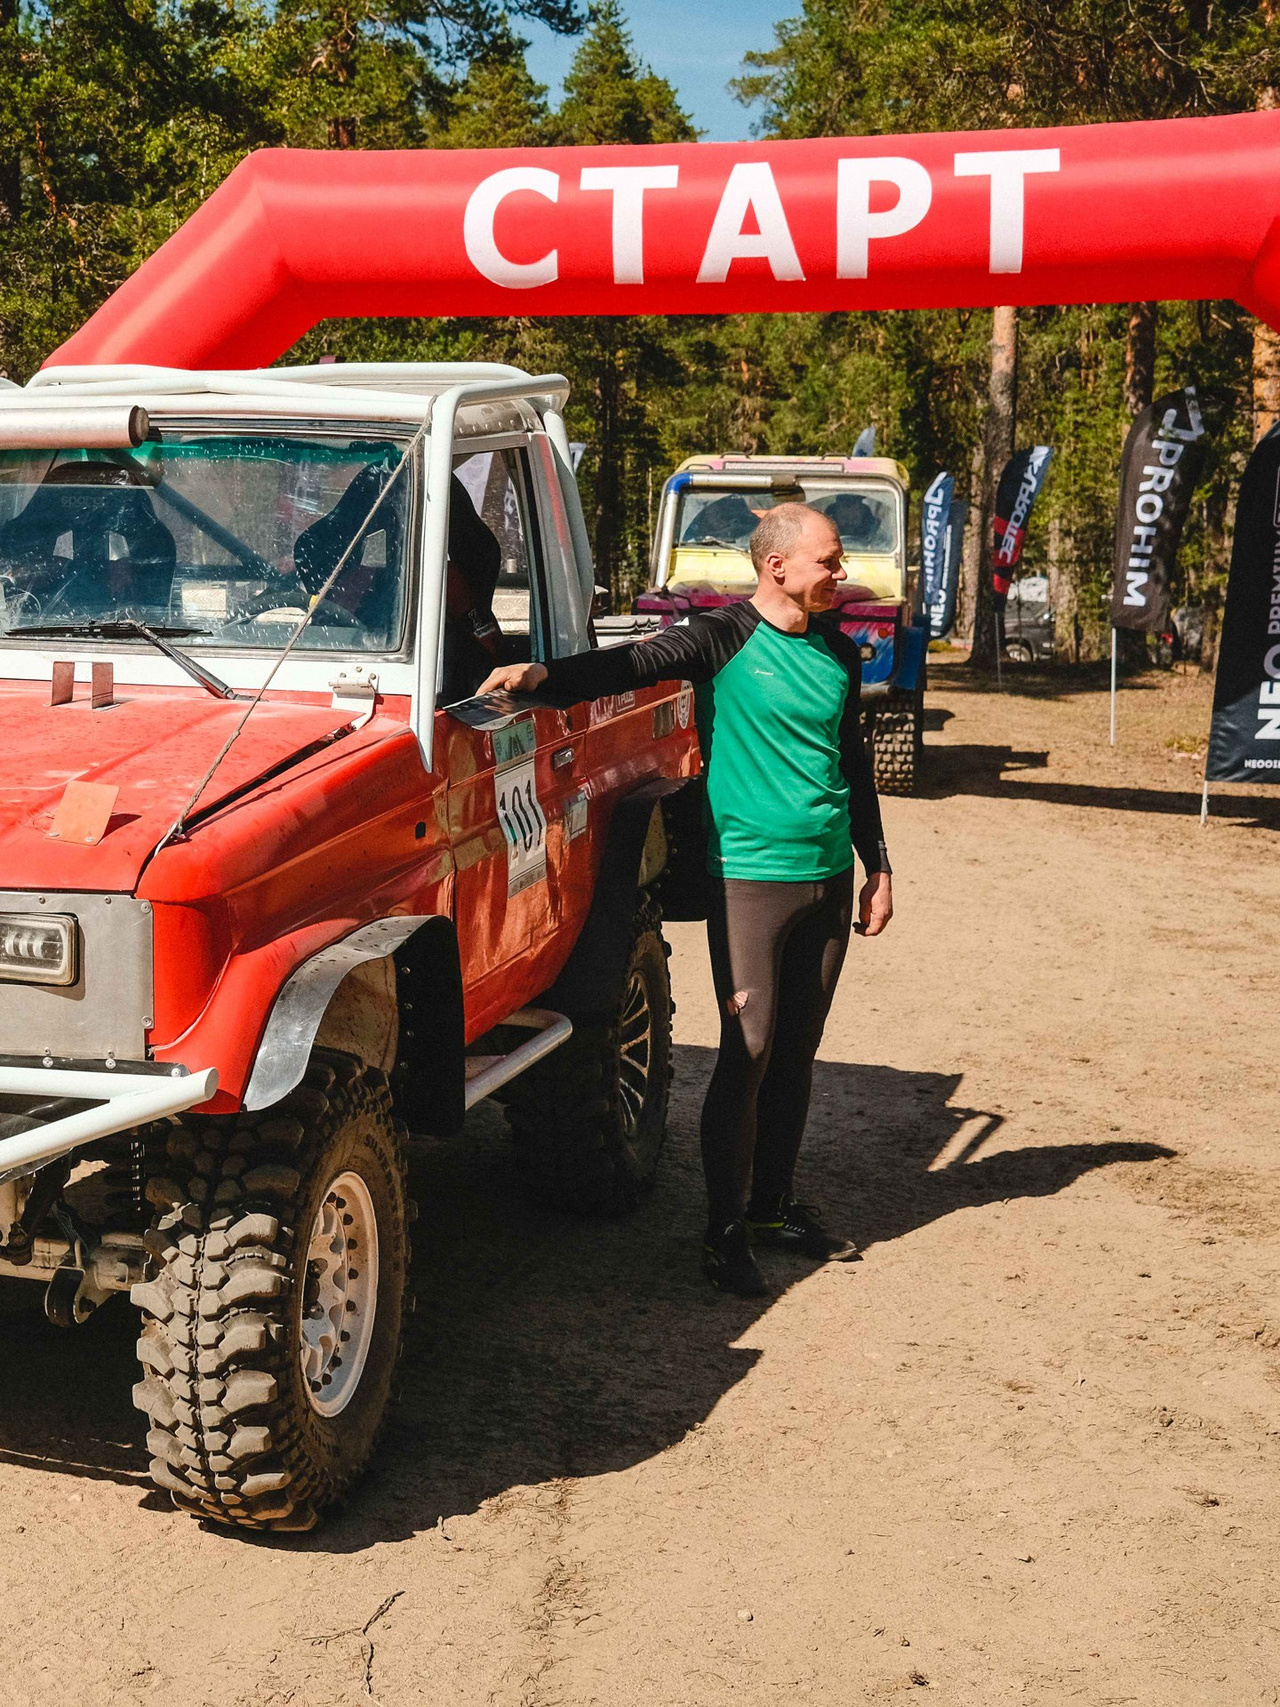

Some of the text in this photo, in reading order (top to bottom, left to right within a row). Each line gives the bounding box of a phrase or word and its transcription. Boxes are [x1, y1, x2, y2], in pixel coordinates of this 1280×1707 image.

[464, 148, 1061, 289] СТАРТ
[1123, 439, 1185, 607] PROHIM
[499, 780, 543, 859] 101
